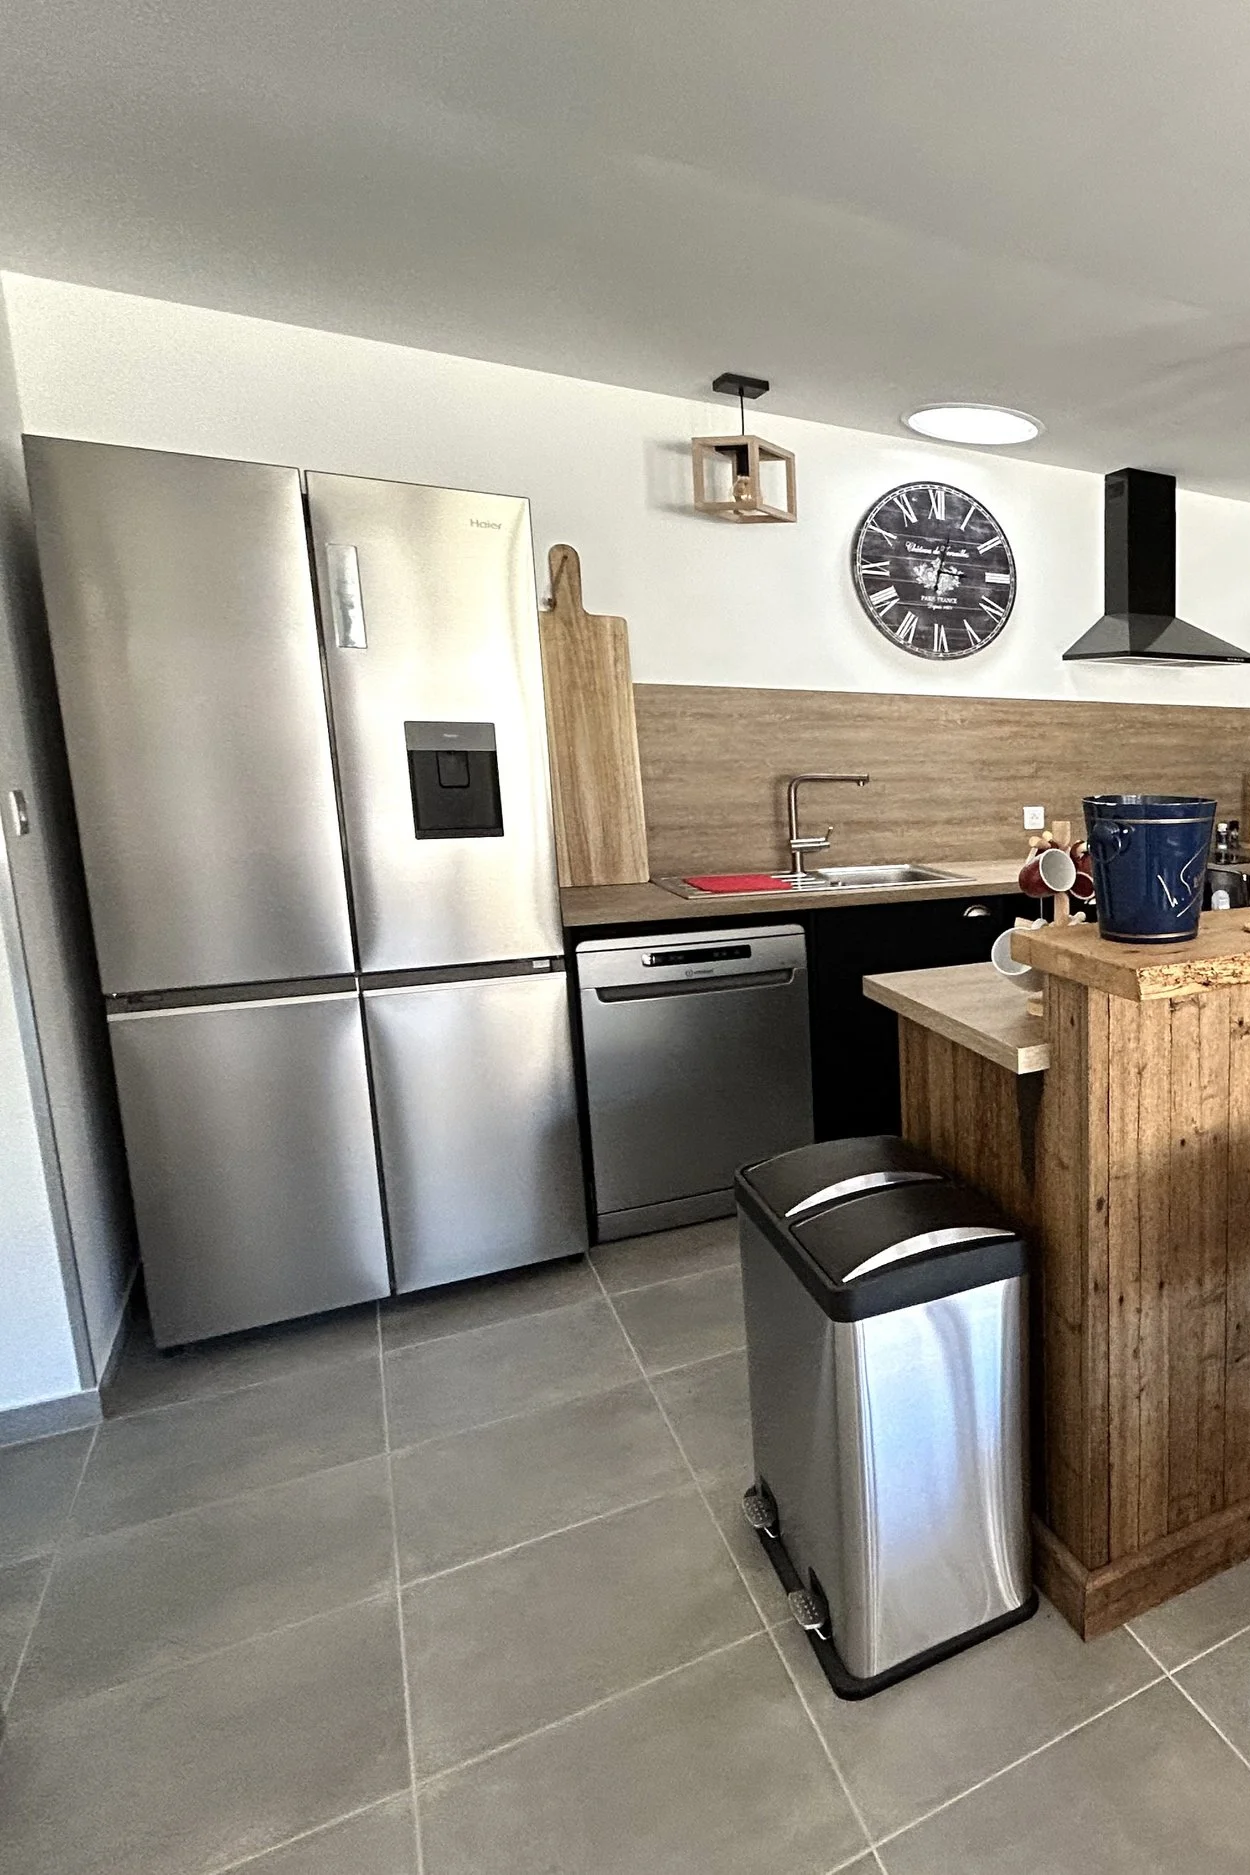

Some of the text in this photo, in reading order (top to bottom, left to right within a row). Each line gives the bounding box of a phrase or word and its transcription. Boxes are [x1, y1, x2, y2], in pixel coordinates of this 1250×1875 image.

[892, 493, 918, 528] XI
[927, 489, 946, 521] XII
[959, 505, 976, 532] I
[469, 519, 502, 530] Haier
[867, 518, 898, 548] X
[976, 535, 1003, 556] II
[861, 558, 891, 578] IX
[984, 571, 1011, 585] III
[895, 610, 920, 644] VII
[933, 623, 950, 653] VI
[962, 618, 982, 646] V
